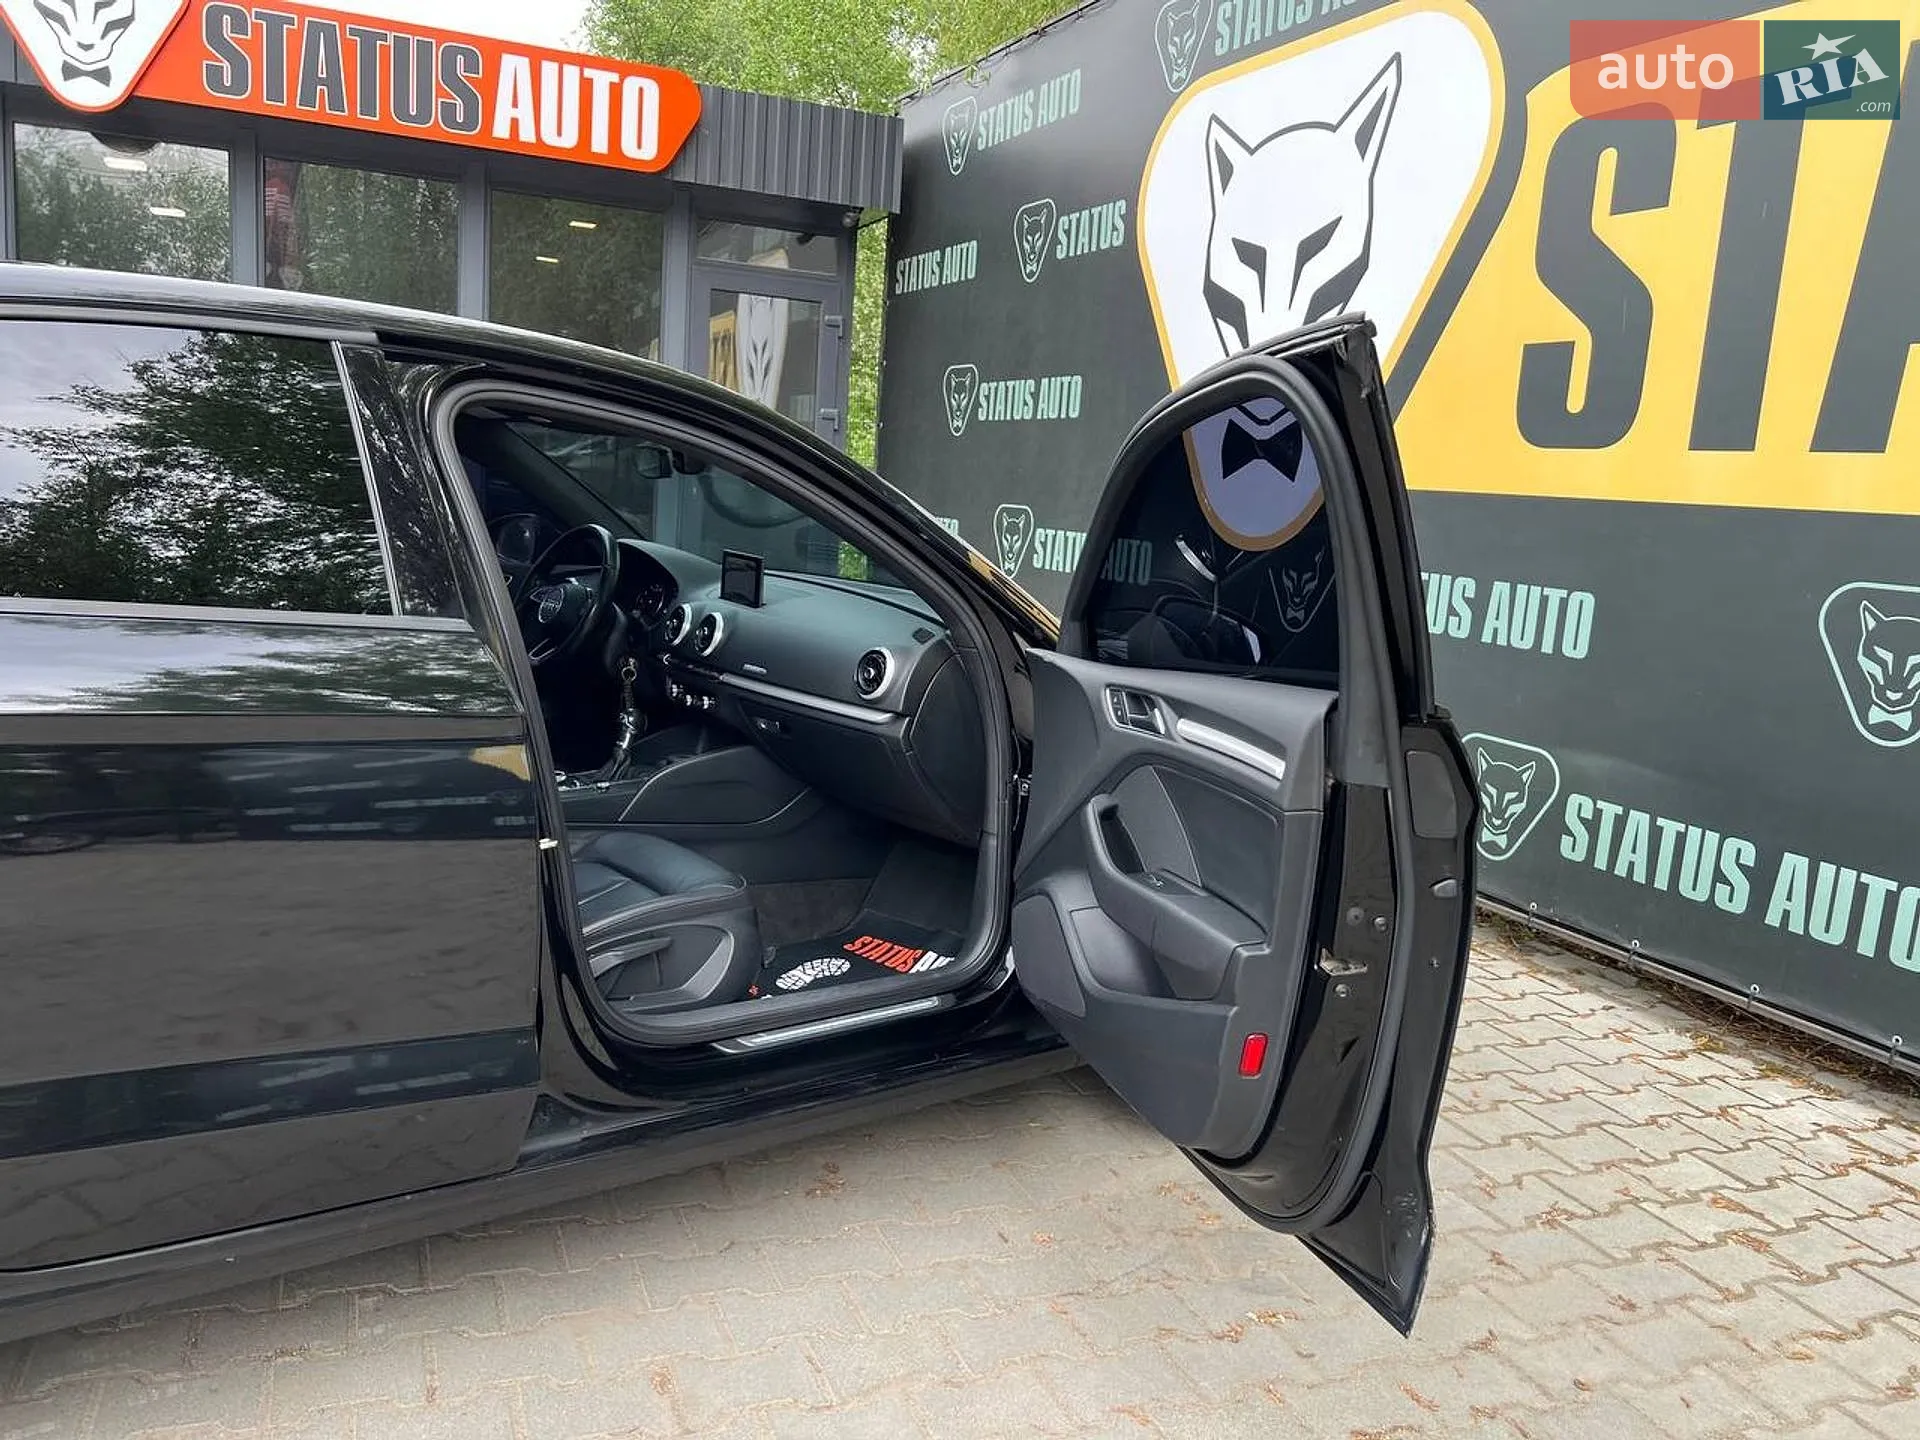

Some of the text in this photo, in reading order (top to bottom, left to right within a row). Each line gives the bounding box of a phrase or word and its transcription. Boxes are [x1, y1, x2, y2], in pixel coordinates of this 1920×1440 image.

[201, 3, 660, 162] STATUS AUTO
[977, 68, 1081, 151] STATUS AUTO
[1056, 199, 1127, 260] STATUS
[895, 240, 978, 295] STATUS AUTO
[978, 375, 1082, 422] STATUS AUTO
[1480, 581, 1596, 660] AUTO
[1560, 793, 1757, 915] STATUS
[843, 936, 923, 972] STATUS
